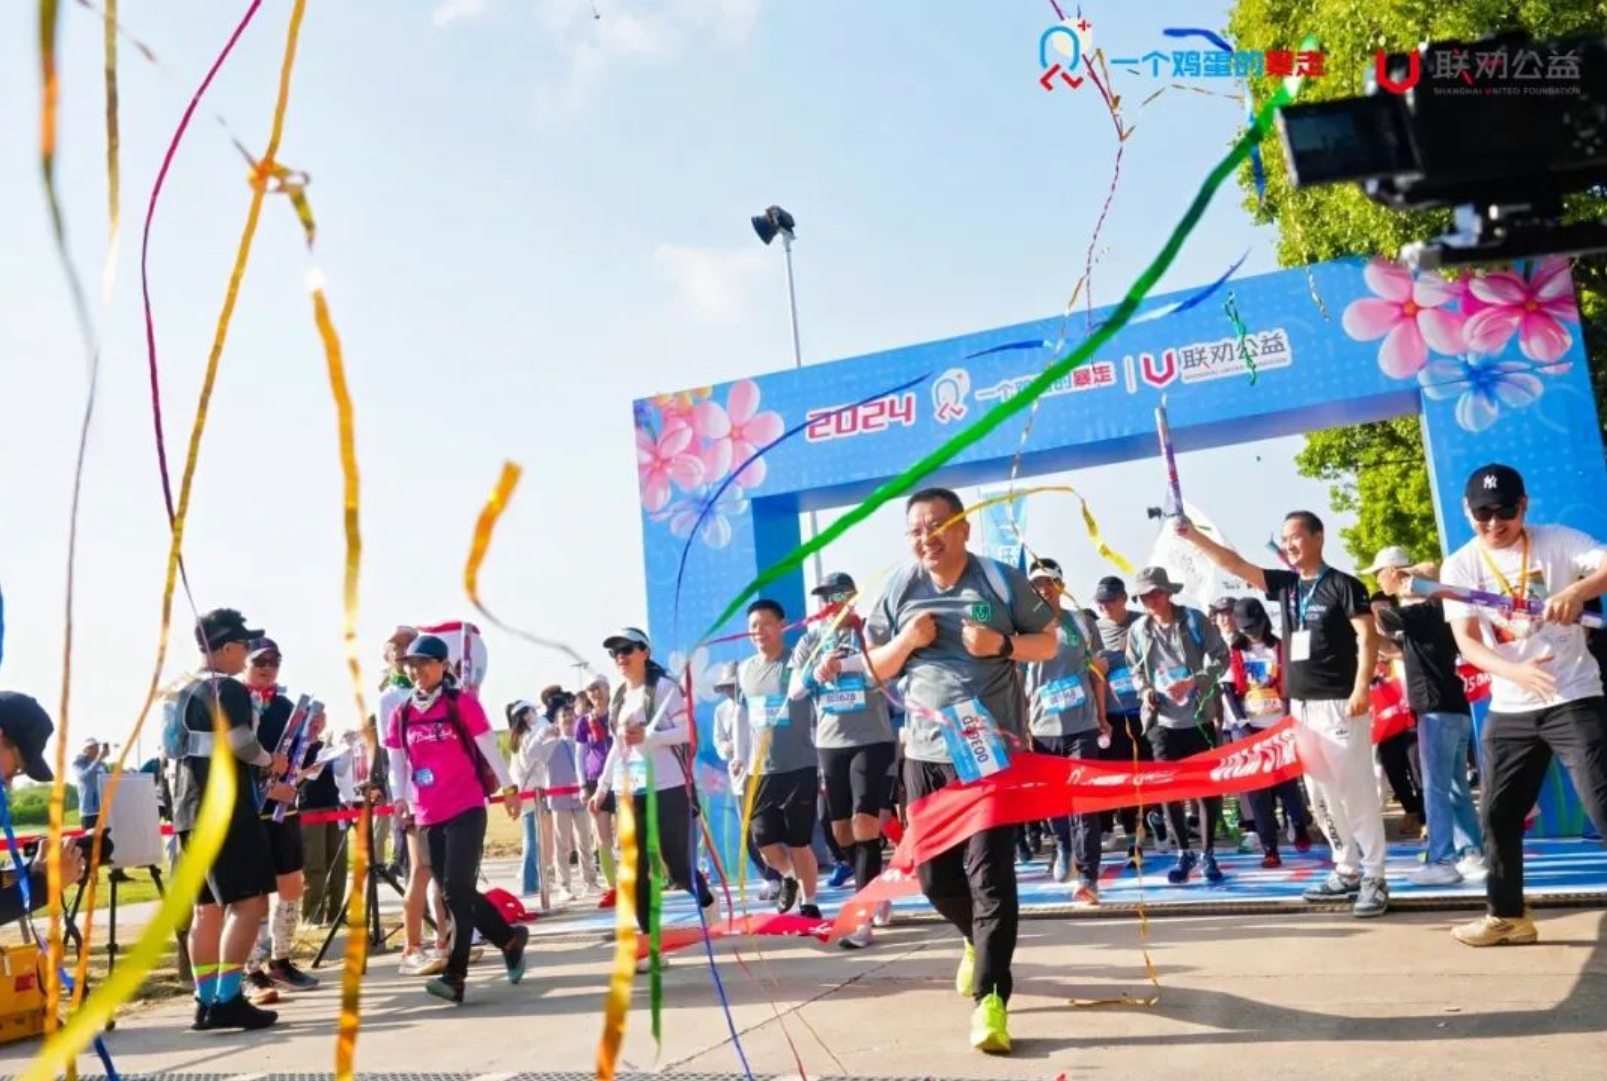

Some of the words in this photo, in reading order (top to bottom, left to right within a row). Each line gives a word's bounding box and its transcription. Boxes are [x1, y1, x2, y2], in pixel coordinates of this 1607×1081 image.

[1182, 332, 1286, 369] 联劝公益
[808, 395, 913, 439] 2024
